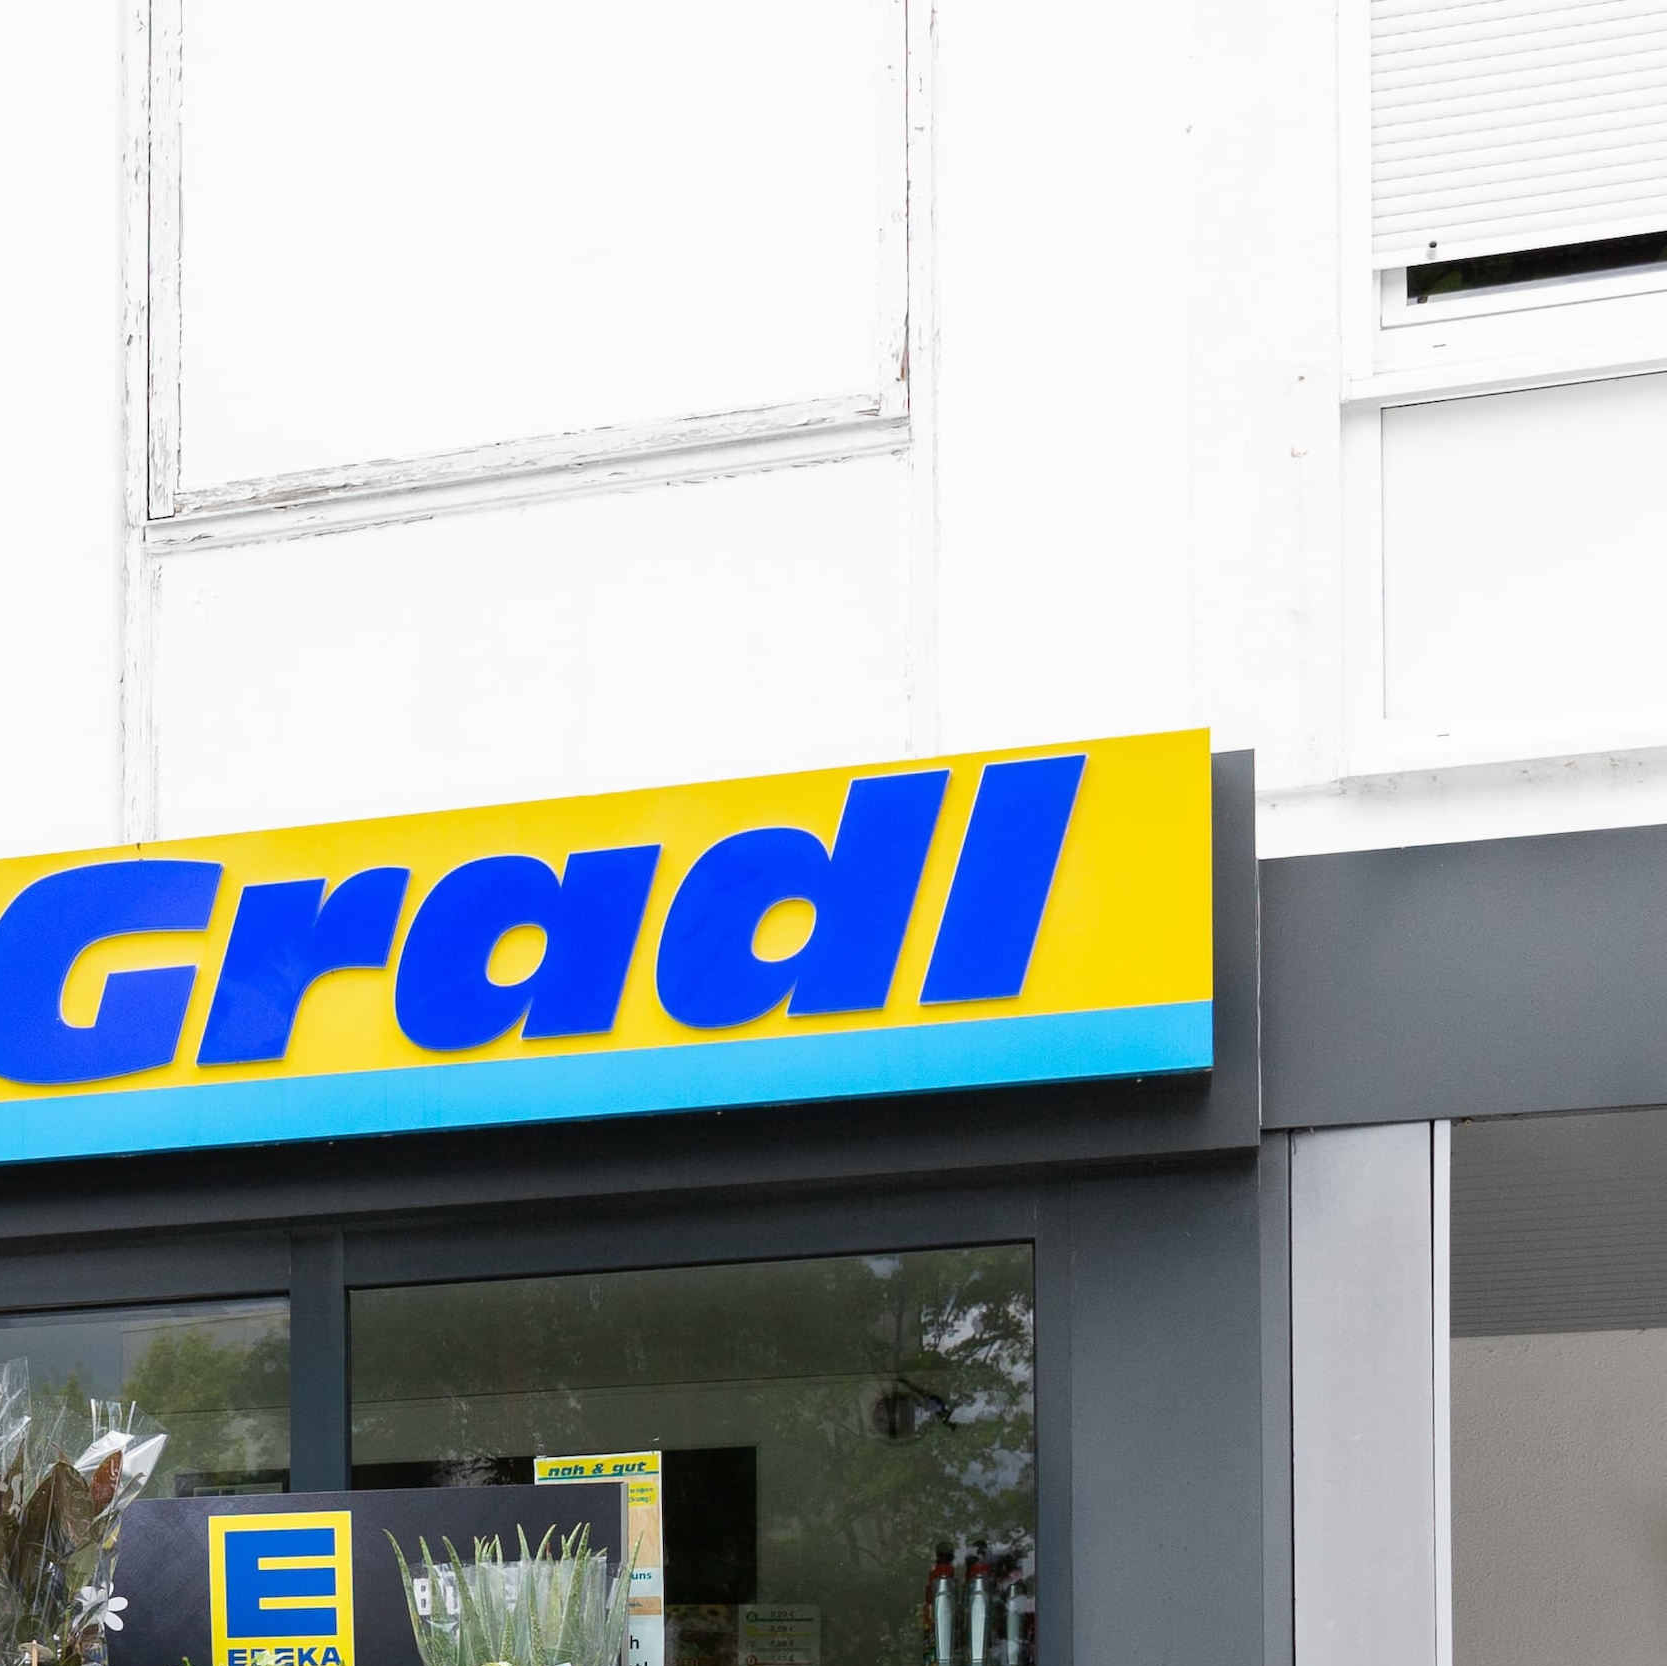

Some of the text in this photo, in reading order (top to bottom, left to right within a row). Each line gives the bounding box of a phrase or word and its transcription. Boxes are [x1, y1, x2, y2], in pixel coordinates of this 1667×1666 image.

[548, 1460, 647, 1477] nah & gut
